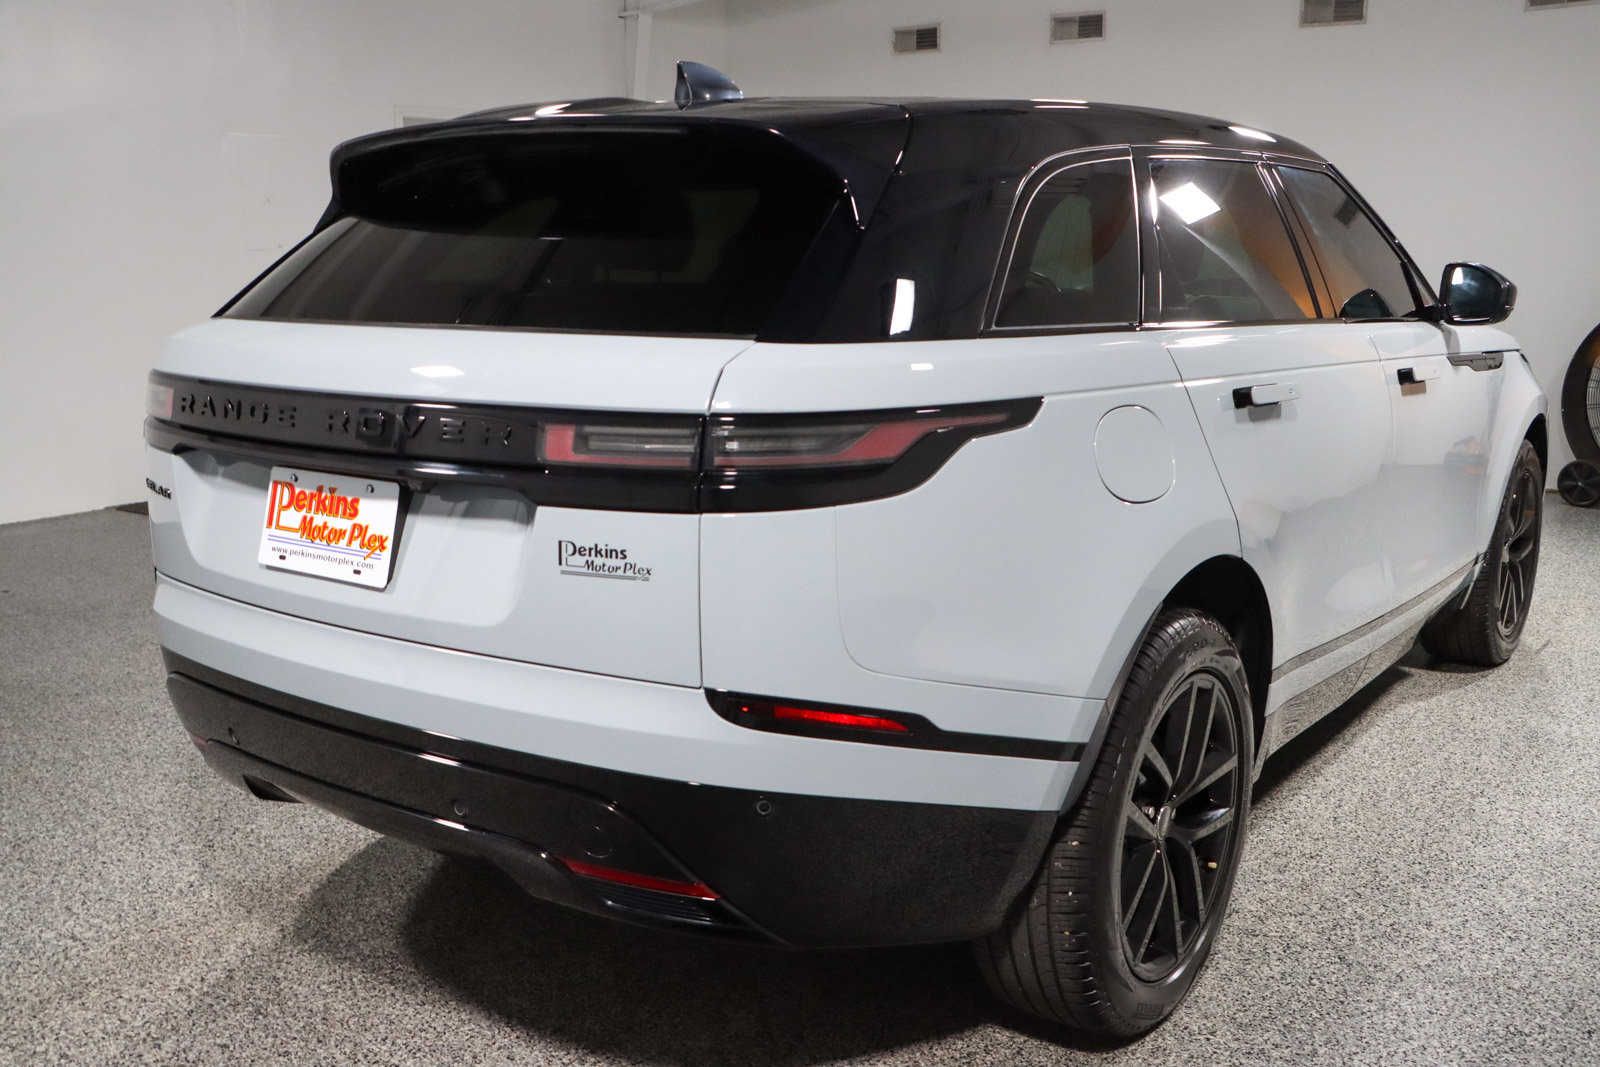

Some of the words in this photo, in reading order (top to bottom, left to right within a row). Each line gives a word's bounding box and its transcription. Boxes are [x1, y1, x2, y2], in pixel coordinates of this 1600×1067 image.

[181, 392, 298, 429] RANGE
[327, 408, 512, 448] ROVER
[266, 480, 361, 532] Perkins
[300, 515, 347, 544] Motor
[346, 523, 389, 560] Plex
[558, 539, 628, 566] Perkins
[271, 546, 374, 570] www.perkinsmotorplex.com
[584, 559, 621, 574] Motor
[623, 562, 652, 579] Plex
